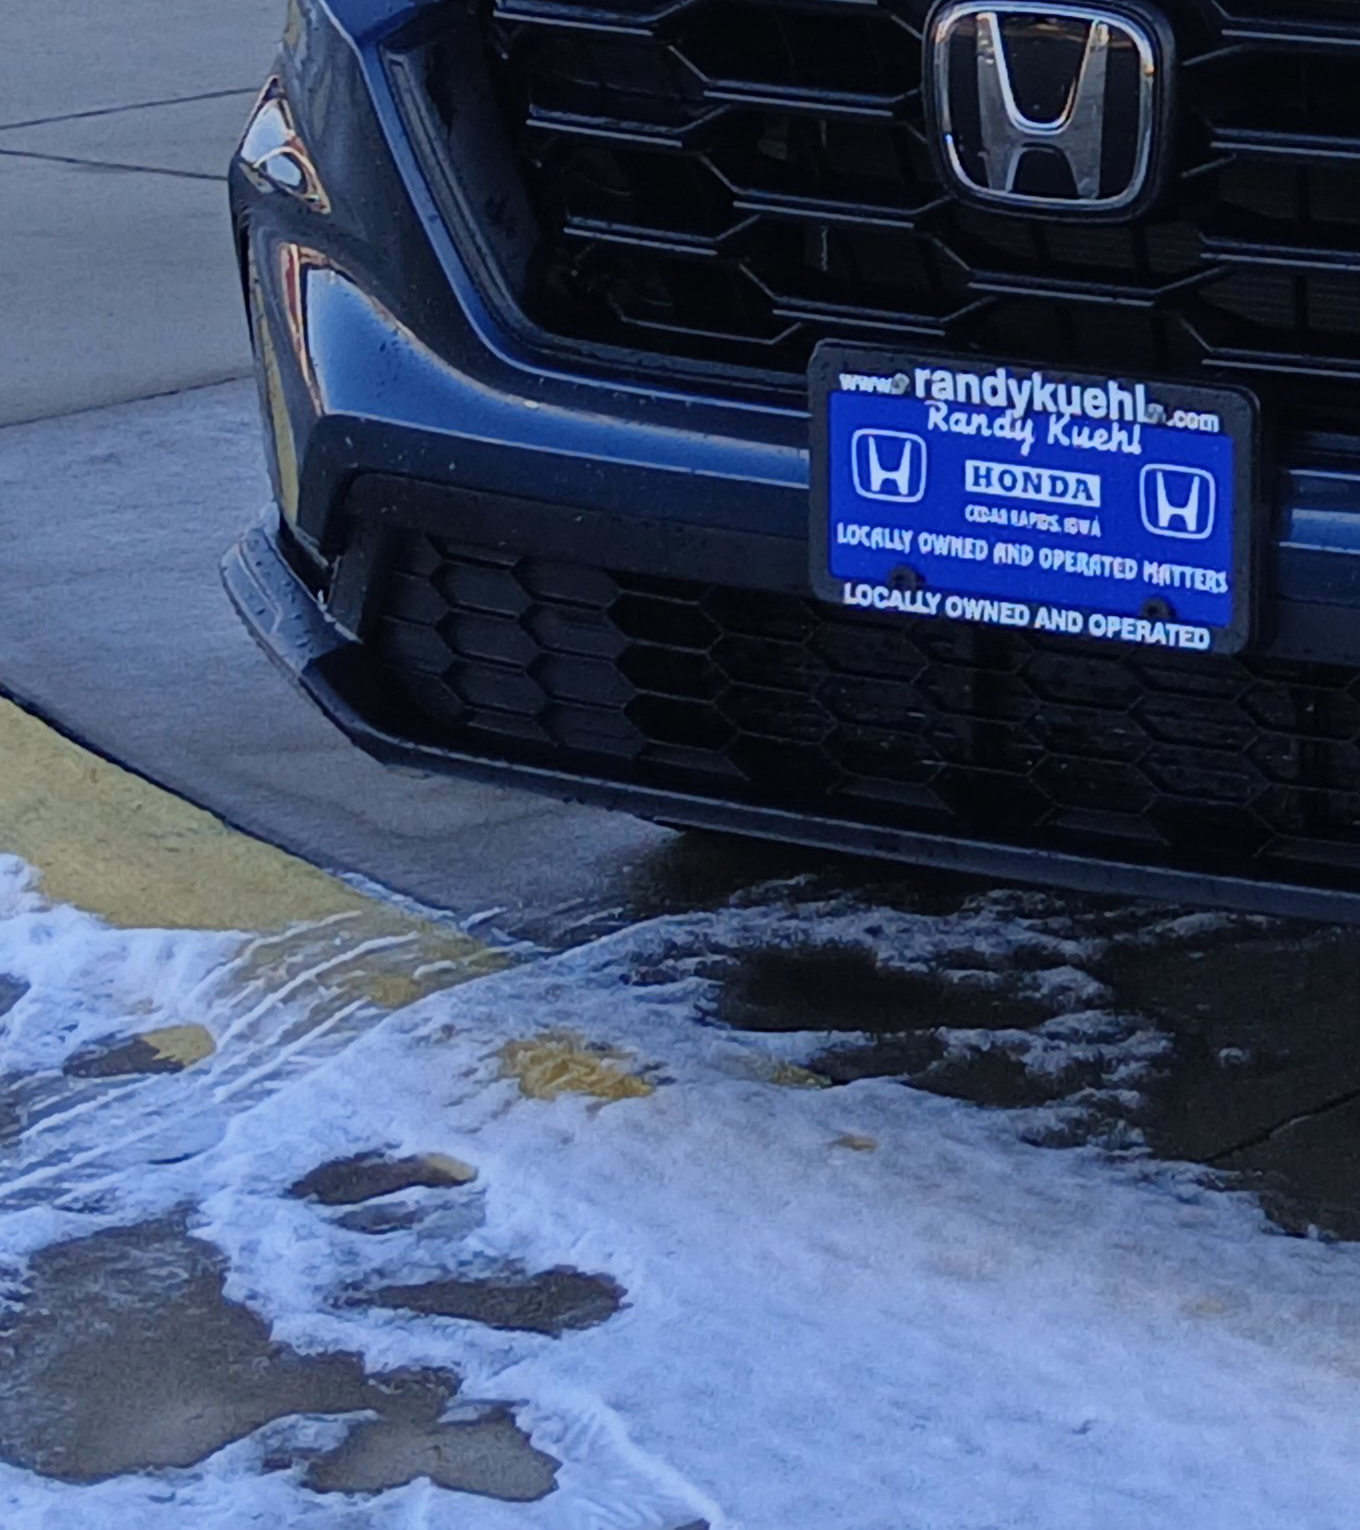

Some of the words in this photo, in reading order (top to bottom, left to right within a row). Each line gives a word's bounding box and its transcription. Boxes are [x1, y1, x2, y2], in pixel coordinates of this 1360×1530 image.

[924, 400, 1035, 456] Randy
[1048, 413, 1142, 455] Kuehl
[972, 464, 1095, 502] HONDA
[837, 522, 914, 554] LOCALLY
[918, 532, 988, 561] OWNED
[993, 542, 1034, 566] AND
[1039, 548, 1138, 580] OPERATED
[1143, 560, 1228, 594] MATTERS
[843, 582, 942, 615] LOCALLY
[945, 595, 1030, 626] OWNED
[1034, 607, 1083, 633] AND
[1088, 613, 1210, 650] OPERATED
